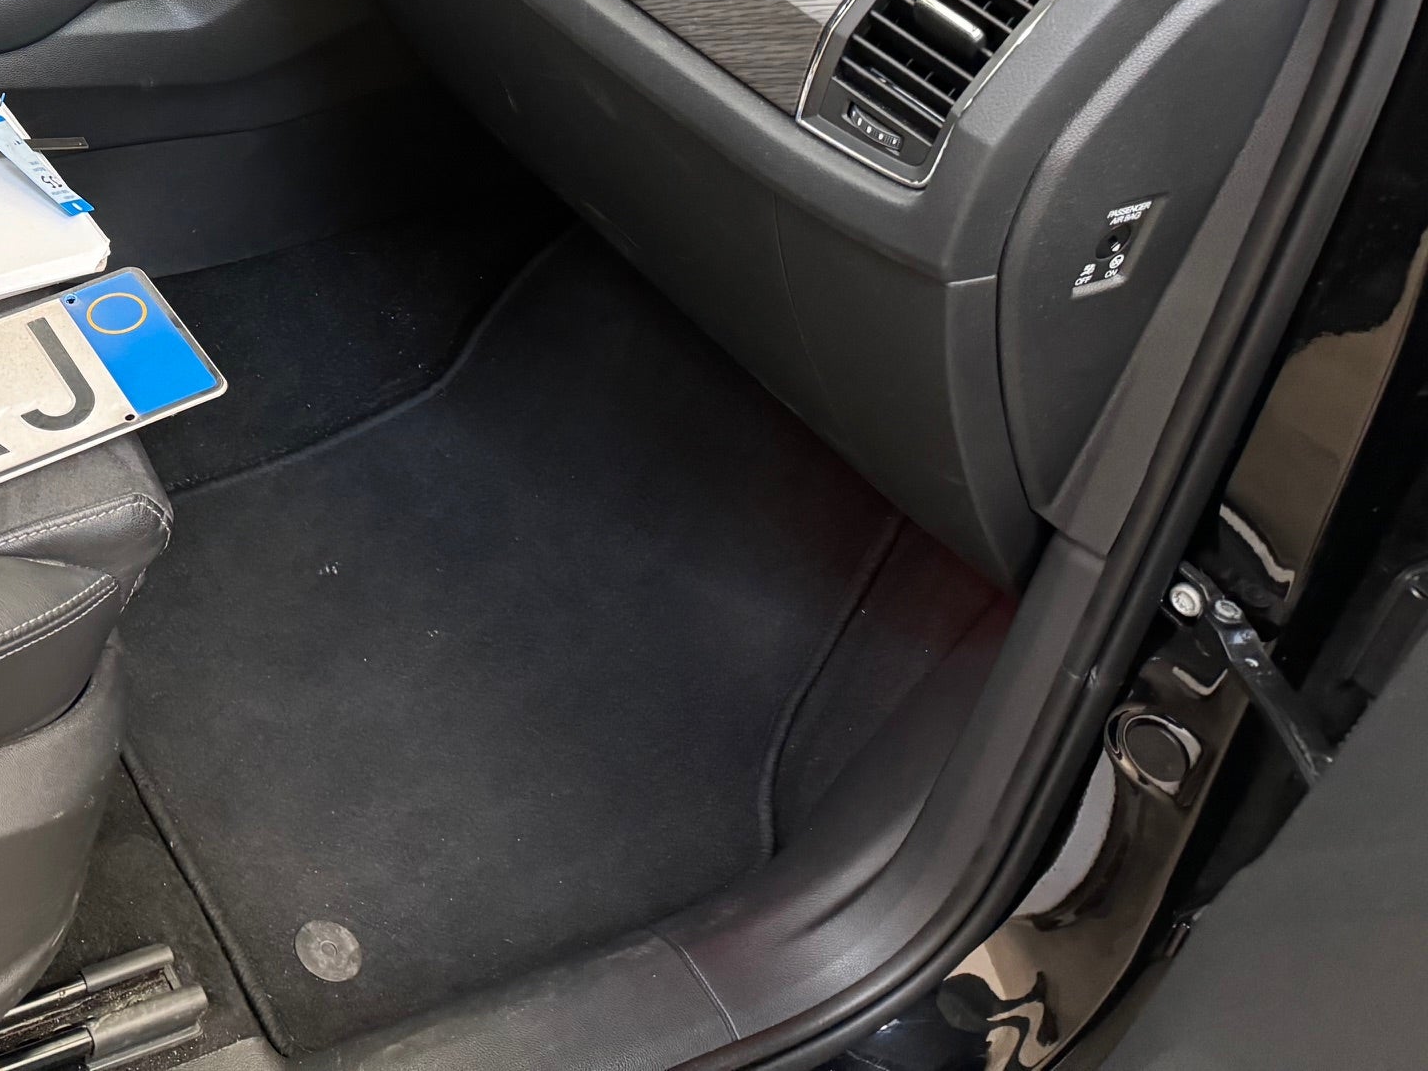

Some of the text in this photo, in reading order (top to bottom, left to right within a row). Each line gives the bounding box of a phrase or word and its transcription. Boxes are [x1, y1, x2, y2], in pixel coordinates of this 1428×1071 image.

[1107, 201, 1152, 219] PASSENGER
[1104, 269, 1119, 278] ON
[1075, 275, 1093, 286] OFF
